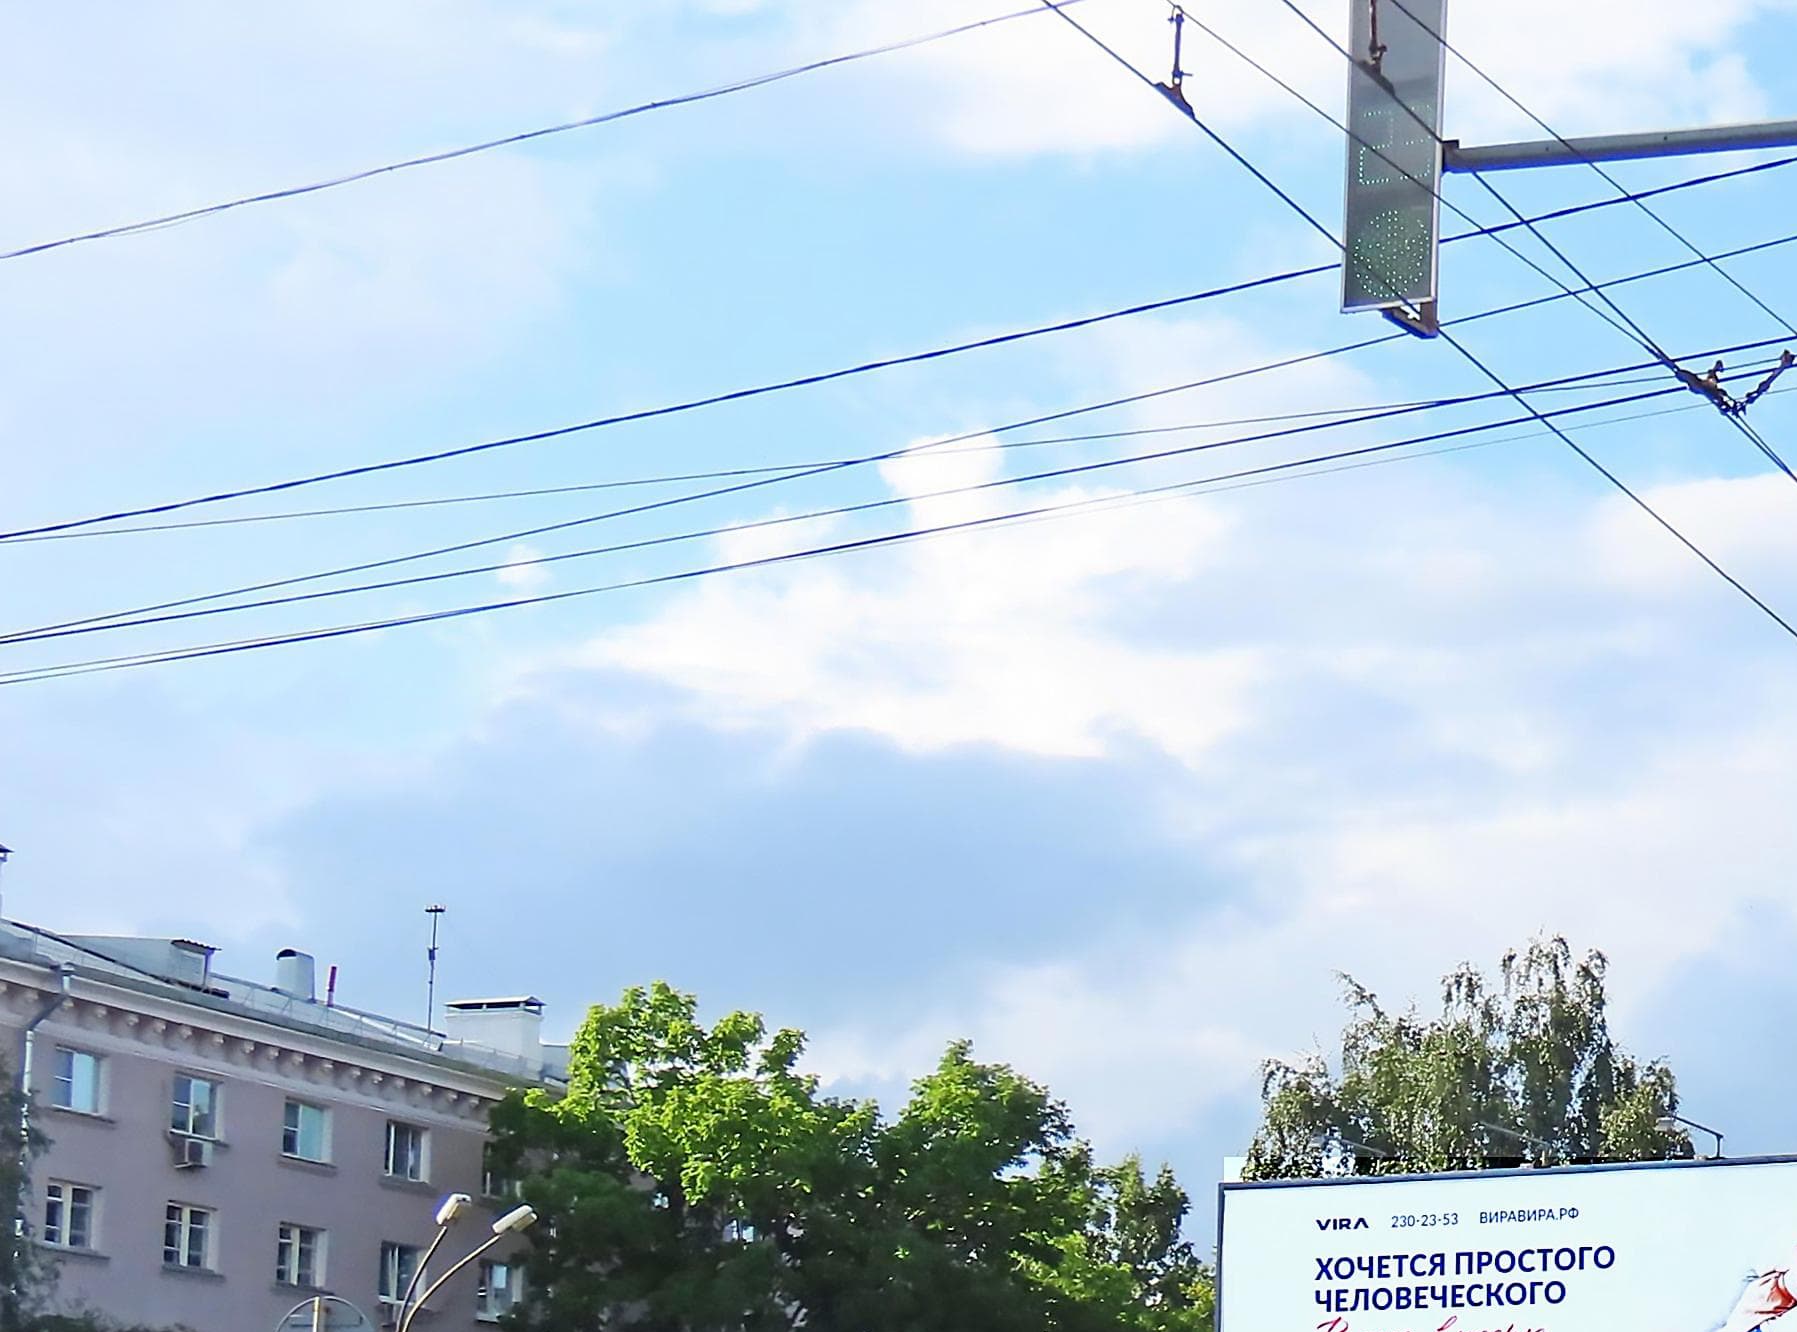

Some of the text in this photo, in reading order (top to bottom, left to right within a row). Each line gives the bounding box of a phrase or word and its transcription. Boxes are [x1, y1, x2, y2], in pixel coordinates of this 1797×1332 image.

[1391, 1207, 1579, 1228] 230-23-53 ВИРАВИРА.РФ
[1315, 1245, 1616, 1281] ХОЧЕТСЯ ПРОСТОГО
[1315, 1280, 1567, 1313] ЧЕЛОВЕЧЕСКОГО
